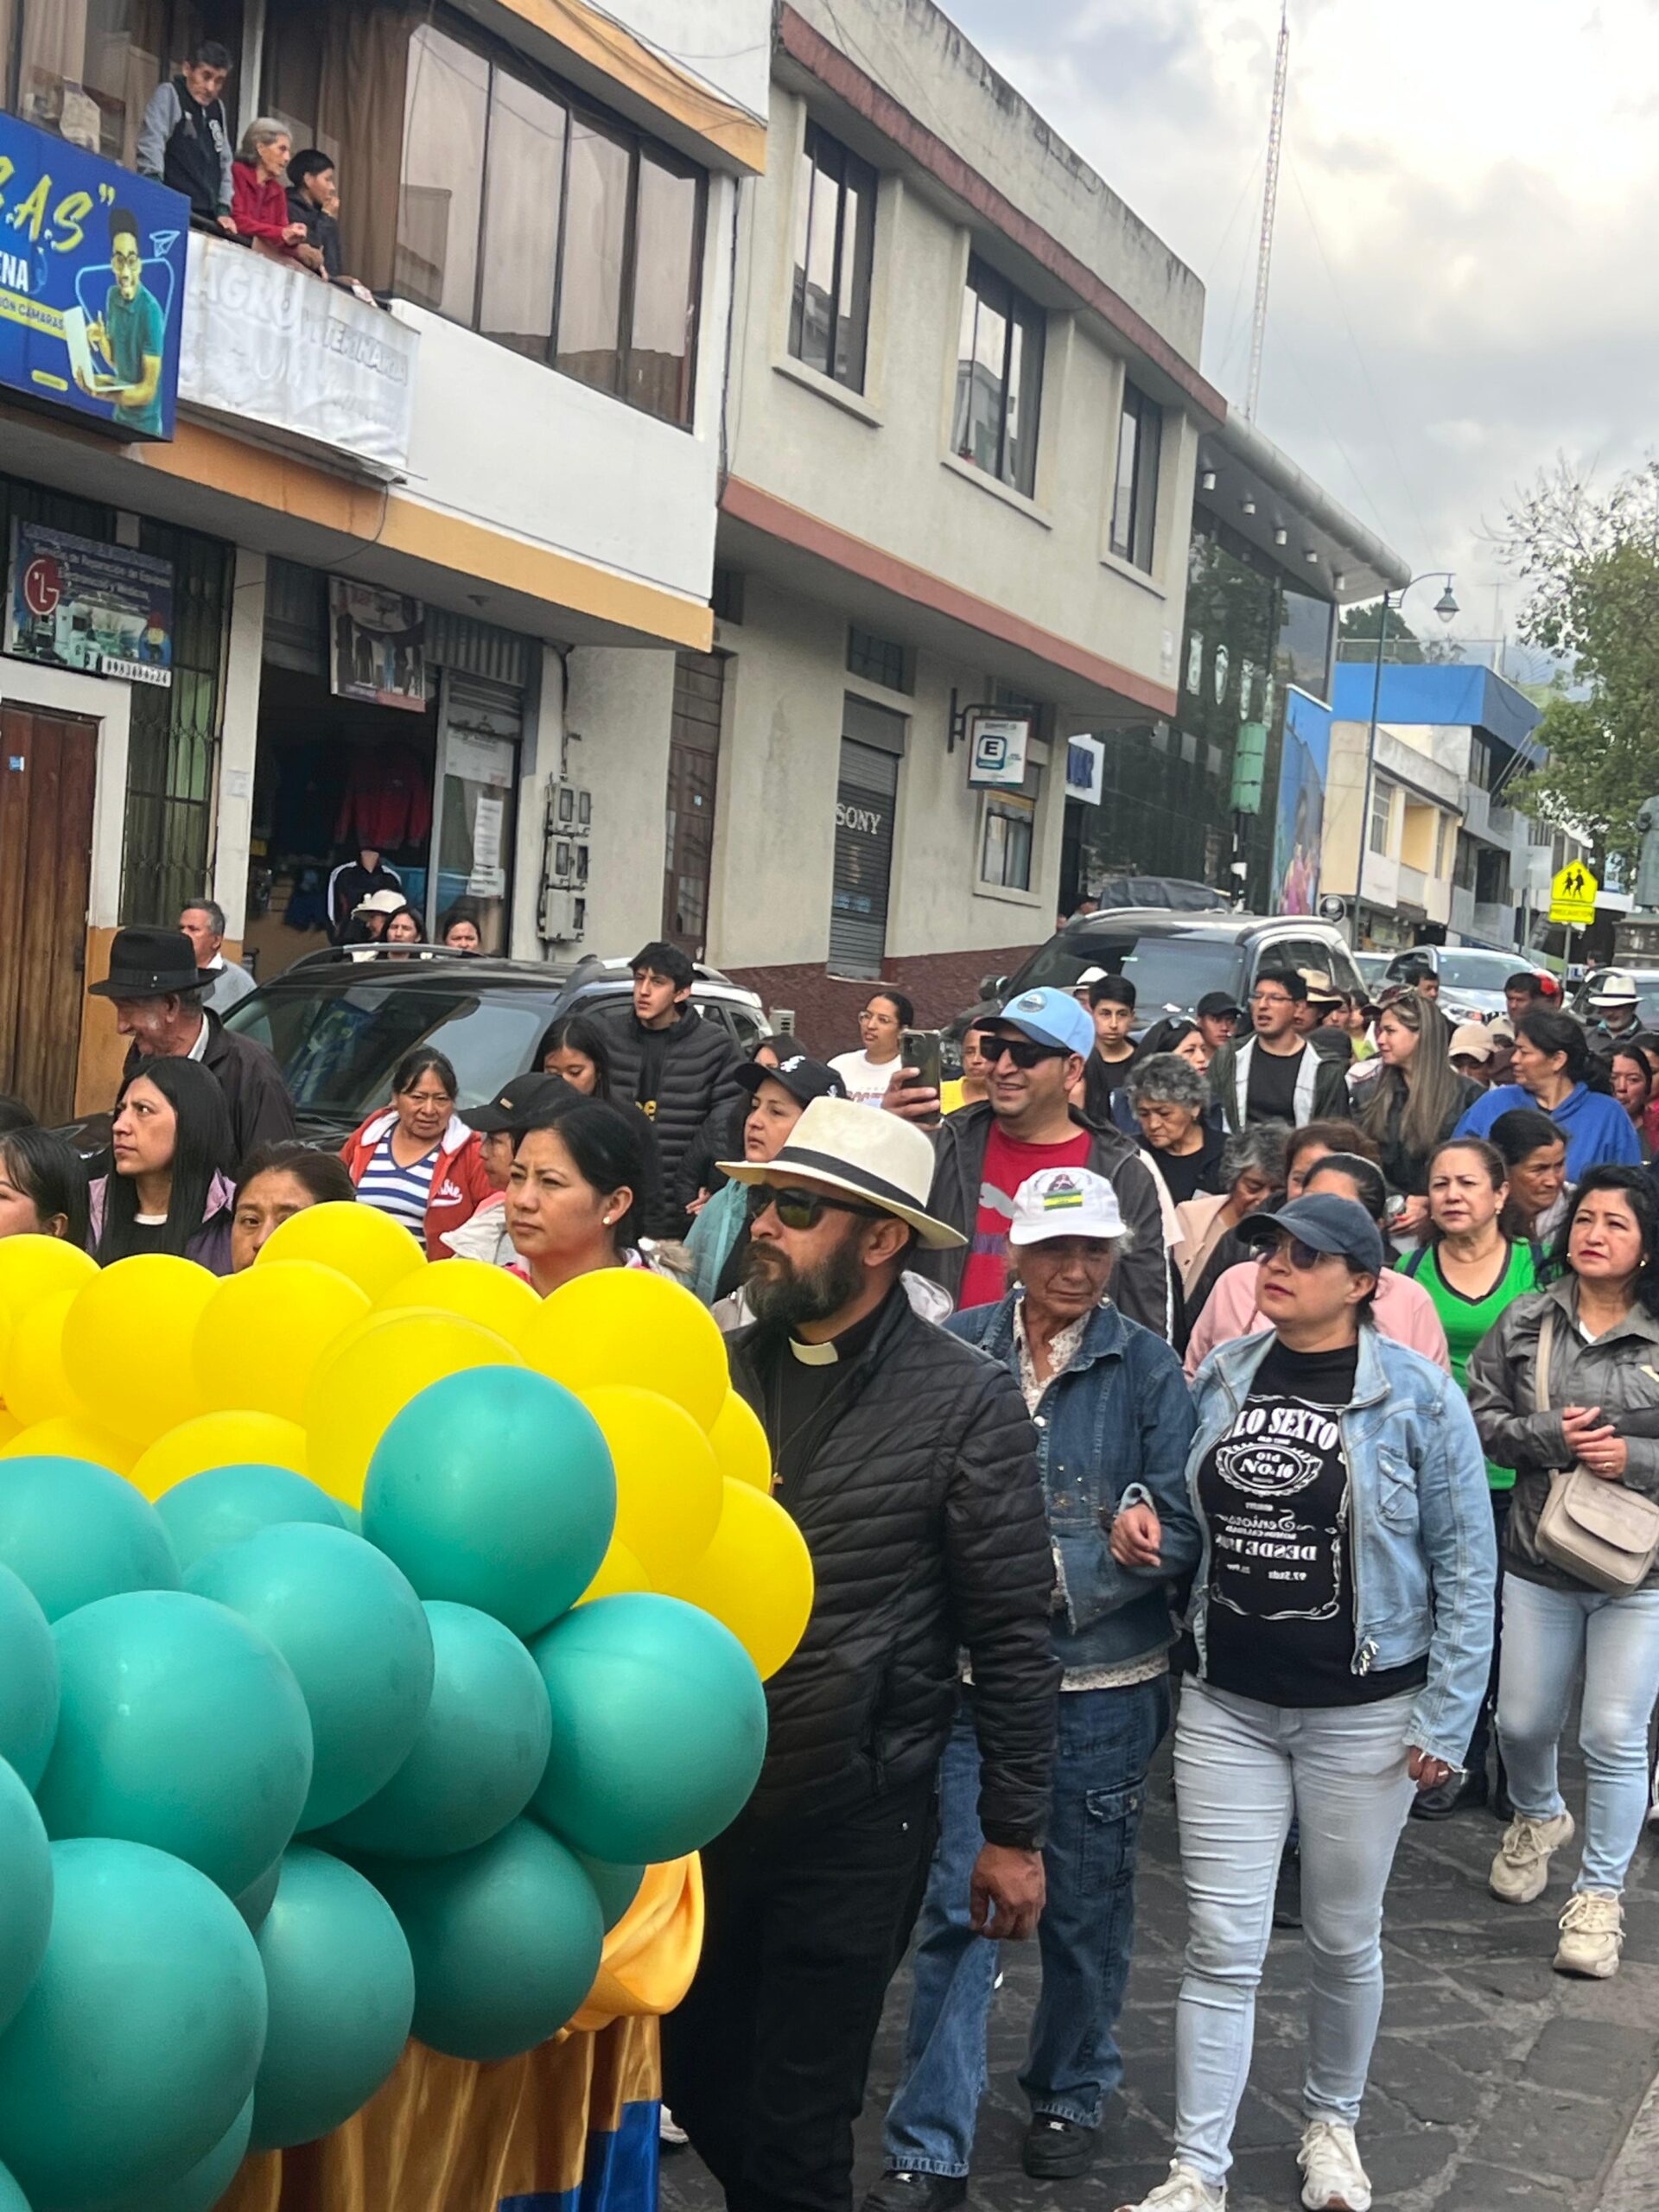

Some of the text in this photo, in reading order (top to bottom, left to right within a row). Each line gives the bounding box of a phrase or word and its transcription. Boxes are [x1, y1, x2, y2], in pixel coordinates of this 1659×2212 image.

[984, 741, 999, 756] E
[836, 802, 881, 835] SONY
[1268, 1408, 1338, 1451] SEXTO
[1255, 1452, 1281, 1464] Old
